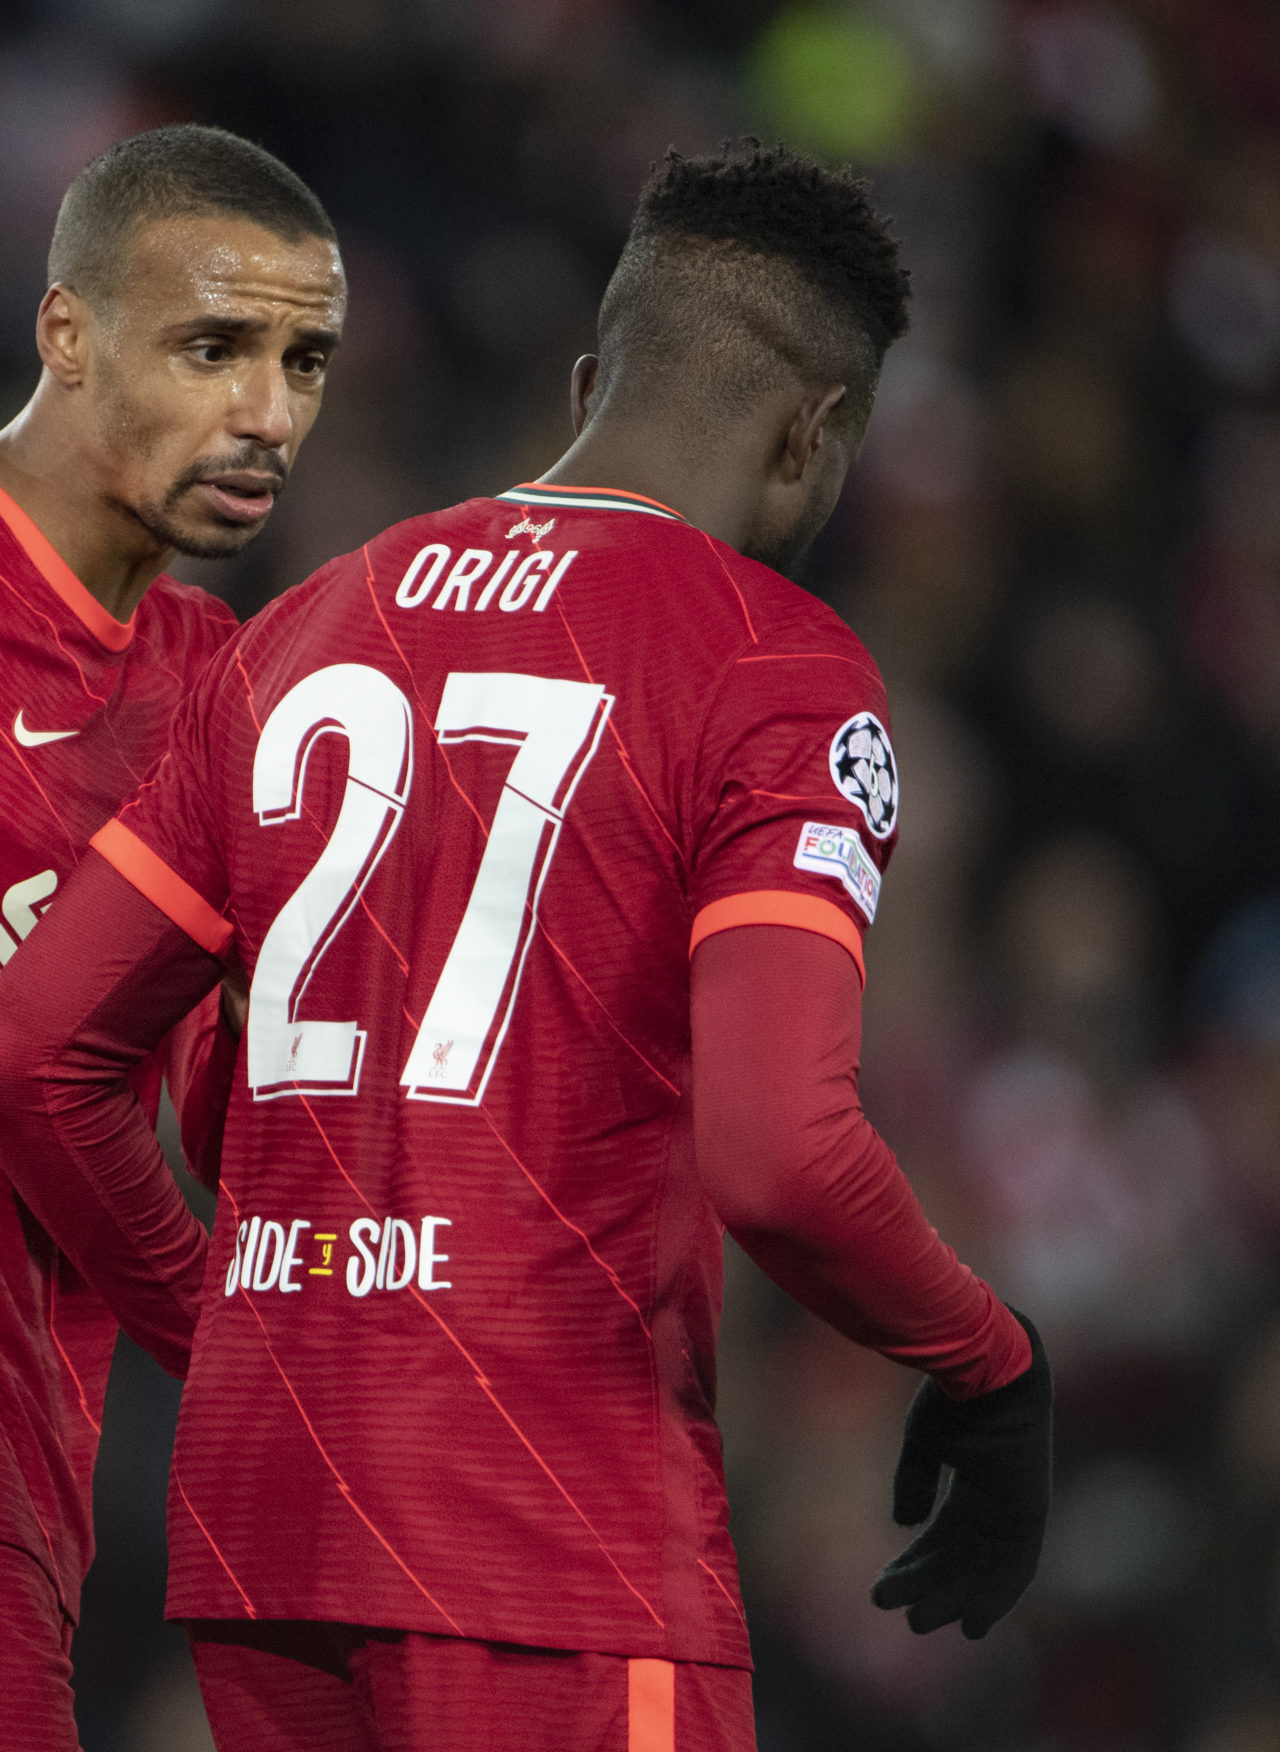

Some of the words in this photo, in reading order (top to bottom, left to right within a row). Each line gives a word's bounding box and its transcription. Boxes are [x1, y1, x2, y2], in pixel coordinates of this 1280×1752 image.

[395, 543, 579, 612] ORIGI
[808, 823, 844, 839] UEFA
[248, 663, 615, 1106] 27
[224, 1216, 312, 1298] SIDE
[346, 1216, 453, 1298] SIDE
